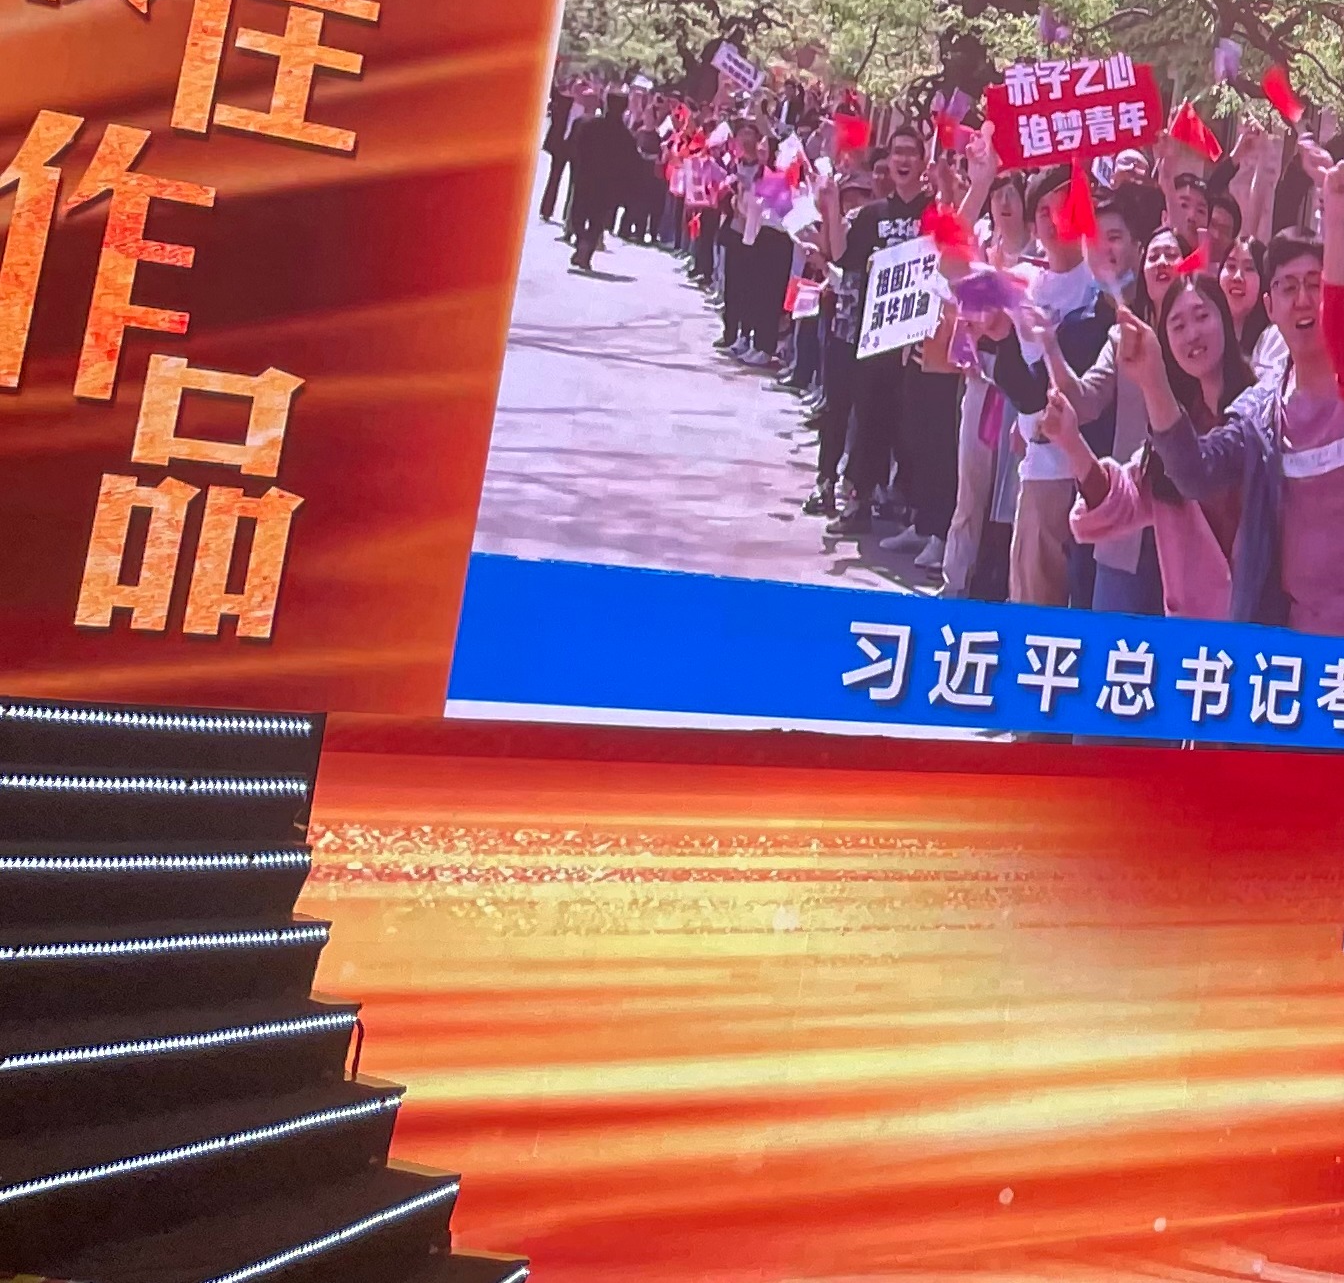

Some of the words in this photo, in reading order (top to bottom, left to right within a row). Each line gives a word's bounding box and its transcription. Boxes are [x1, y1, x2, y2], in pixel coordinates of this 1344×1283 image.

[1005, 51, 1137, 107] 赤子之心
[1018, 100, 1149, 158] 追梦青年
